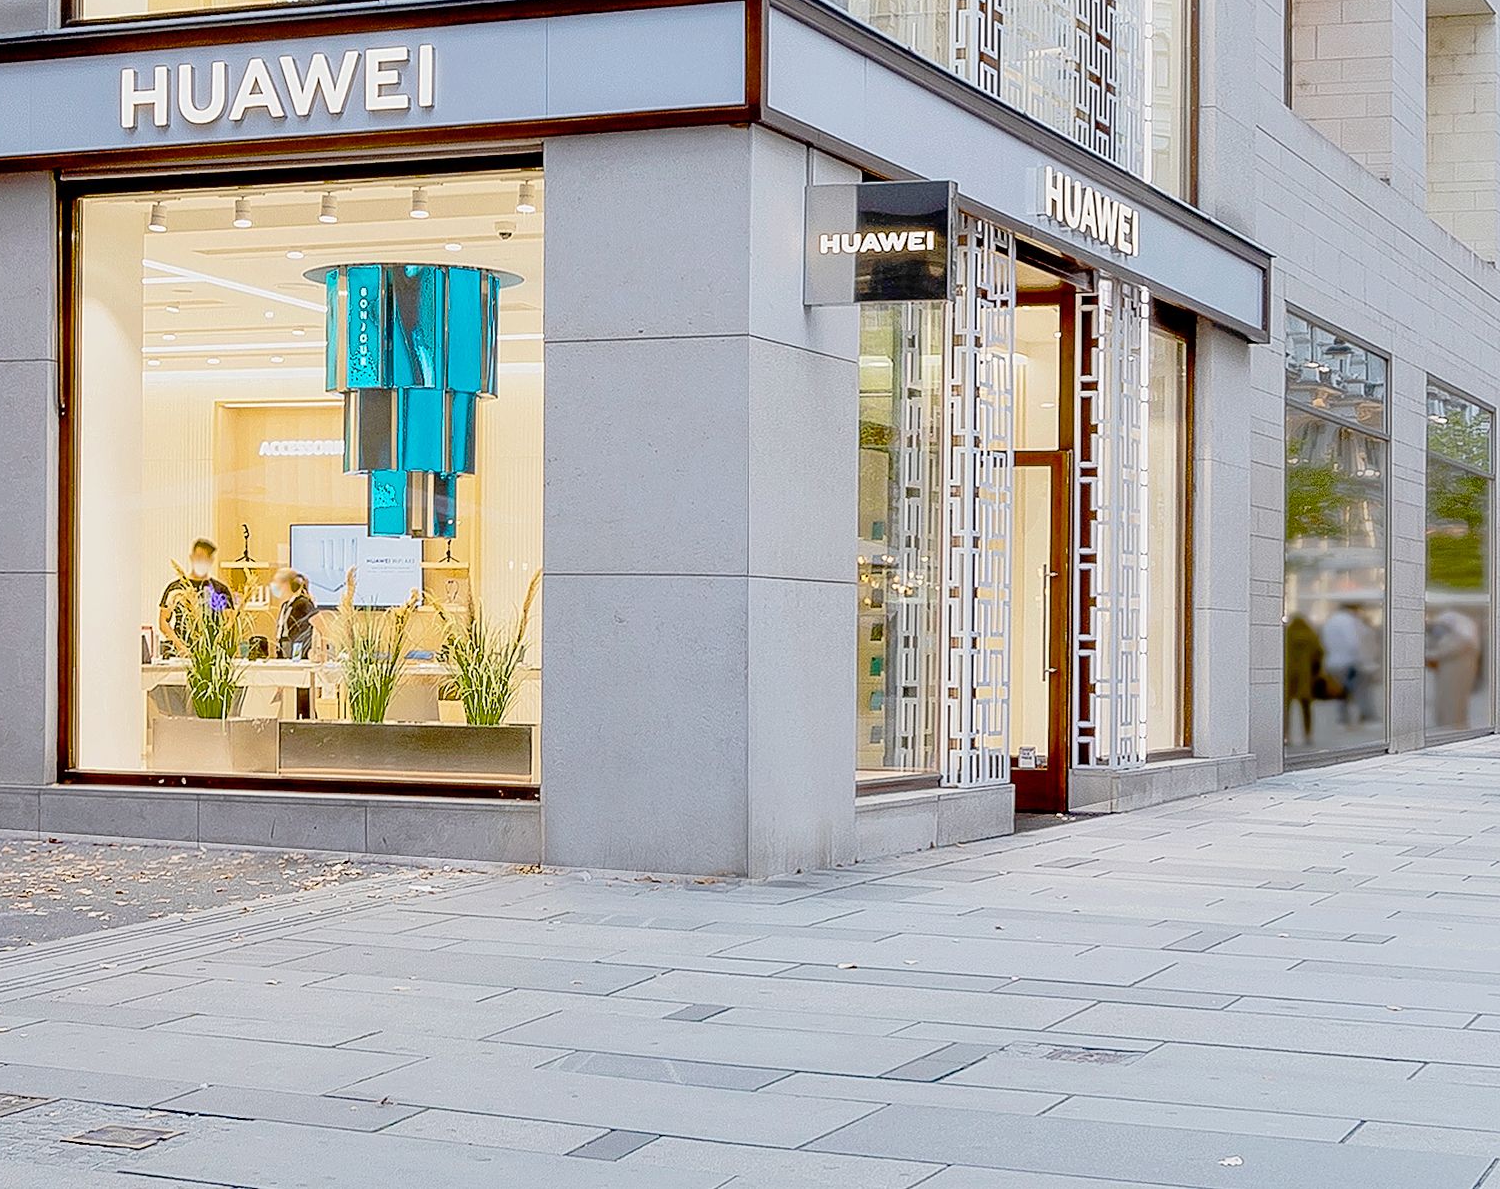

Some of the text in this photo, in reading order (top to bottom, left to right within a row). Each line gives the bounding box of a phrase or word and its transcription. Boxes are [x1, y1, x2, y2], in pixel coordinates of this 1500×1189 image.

[121, 44, 434, 129] HUAWEI
[819, 230, 935, 254] HUAWEI
[1045, 165, 1139, 257] HUAWEI
